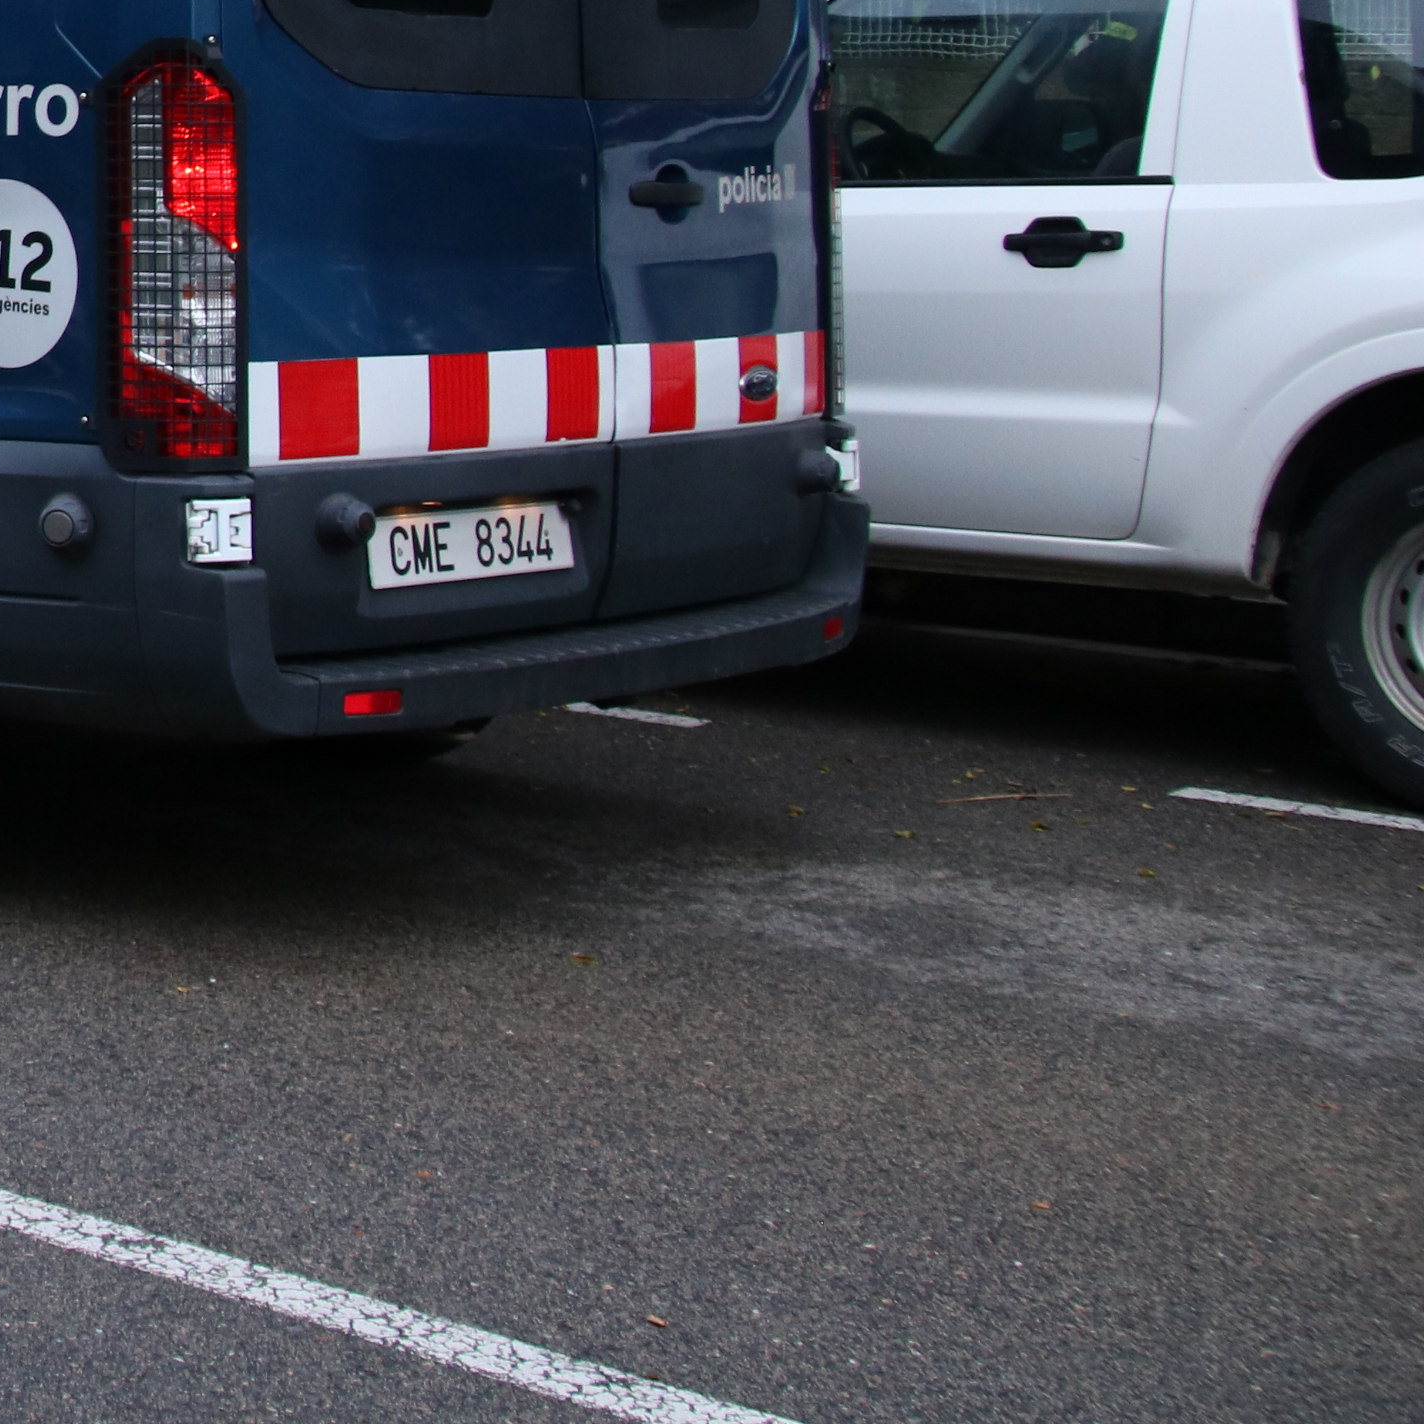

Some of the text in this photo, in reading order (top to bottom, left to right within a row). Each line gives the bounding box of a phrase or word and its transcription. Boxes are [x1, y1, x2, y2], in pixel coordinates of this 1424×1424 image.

[718, 165, 782, 213] policia
[390, 513, 554, 576] CME 8344
